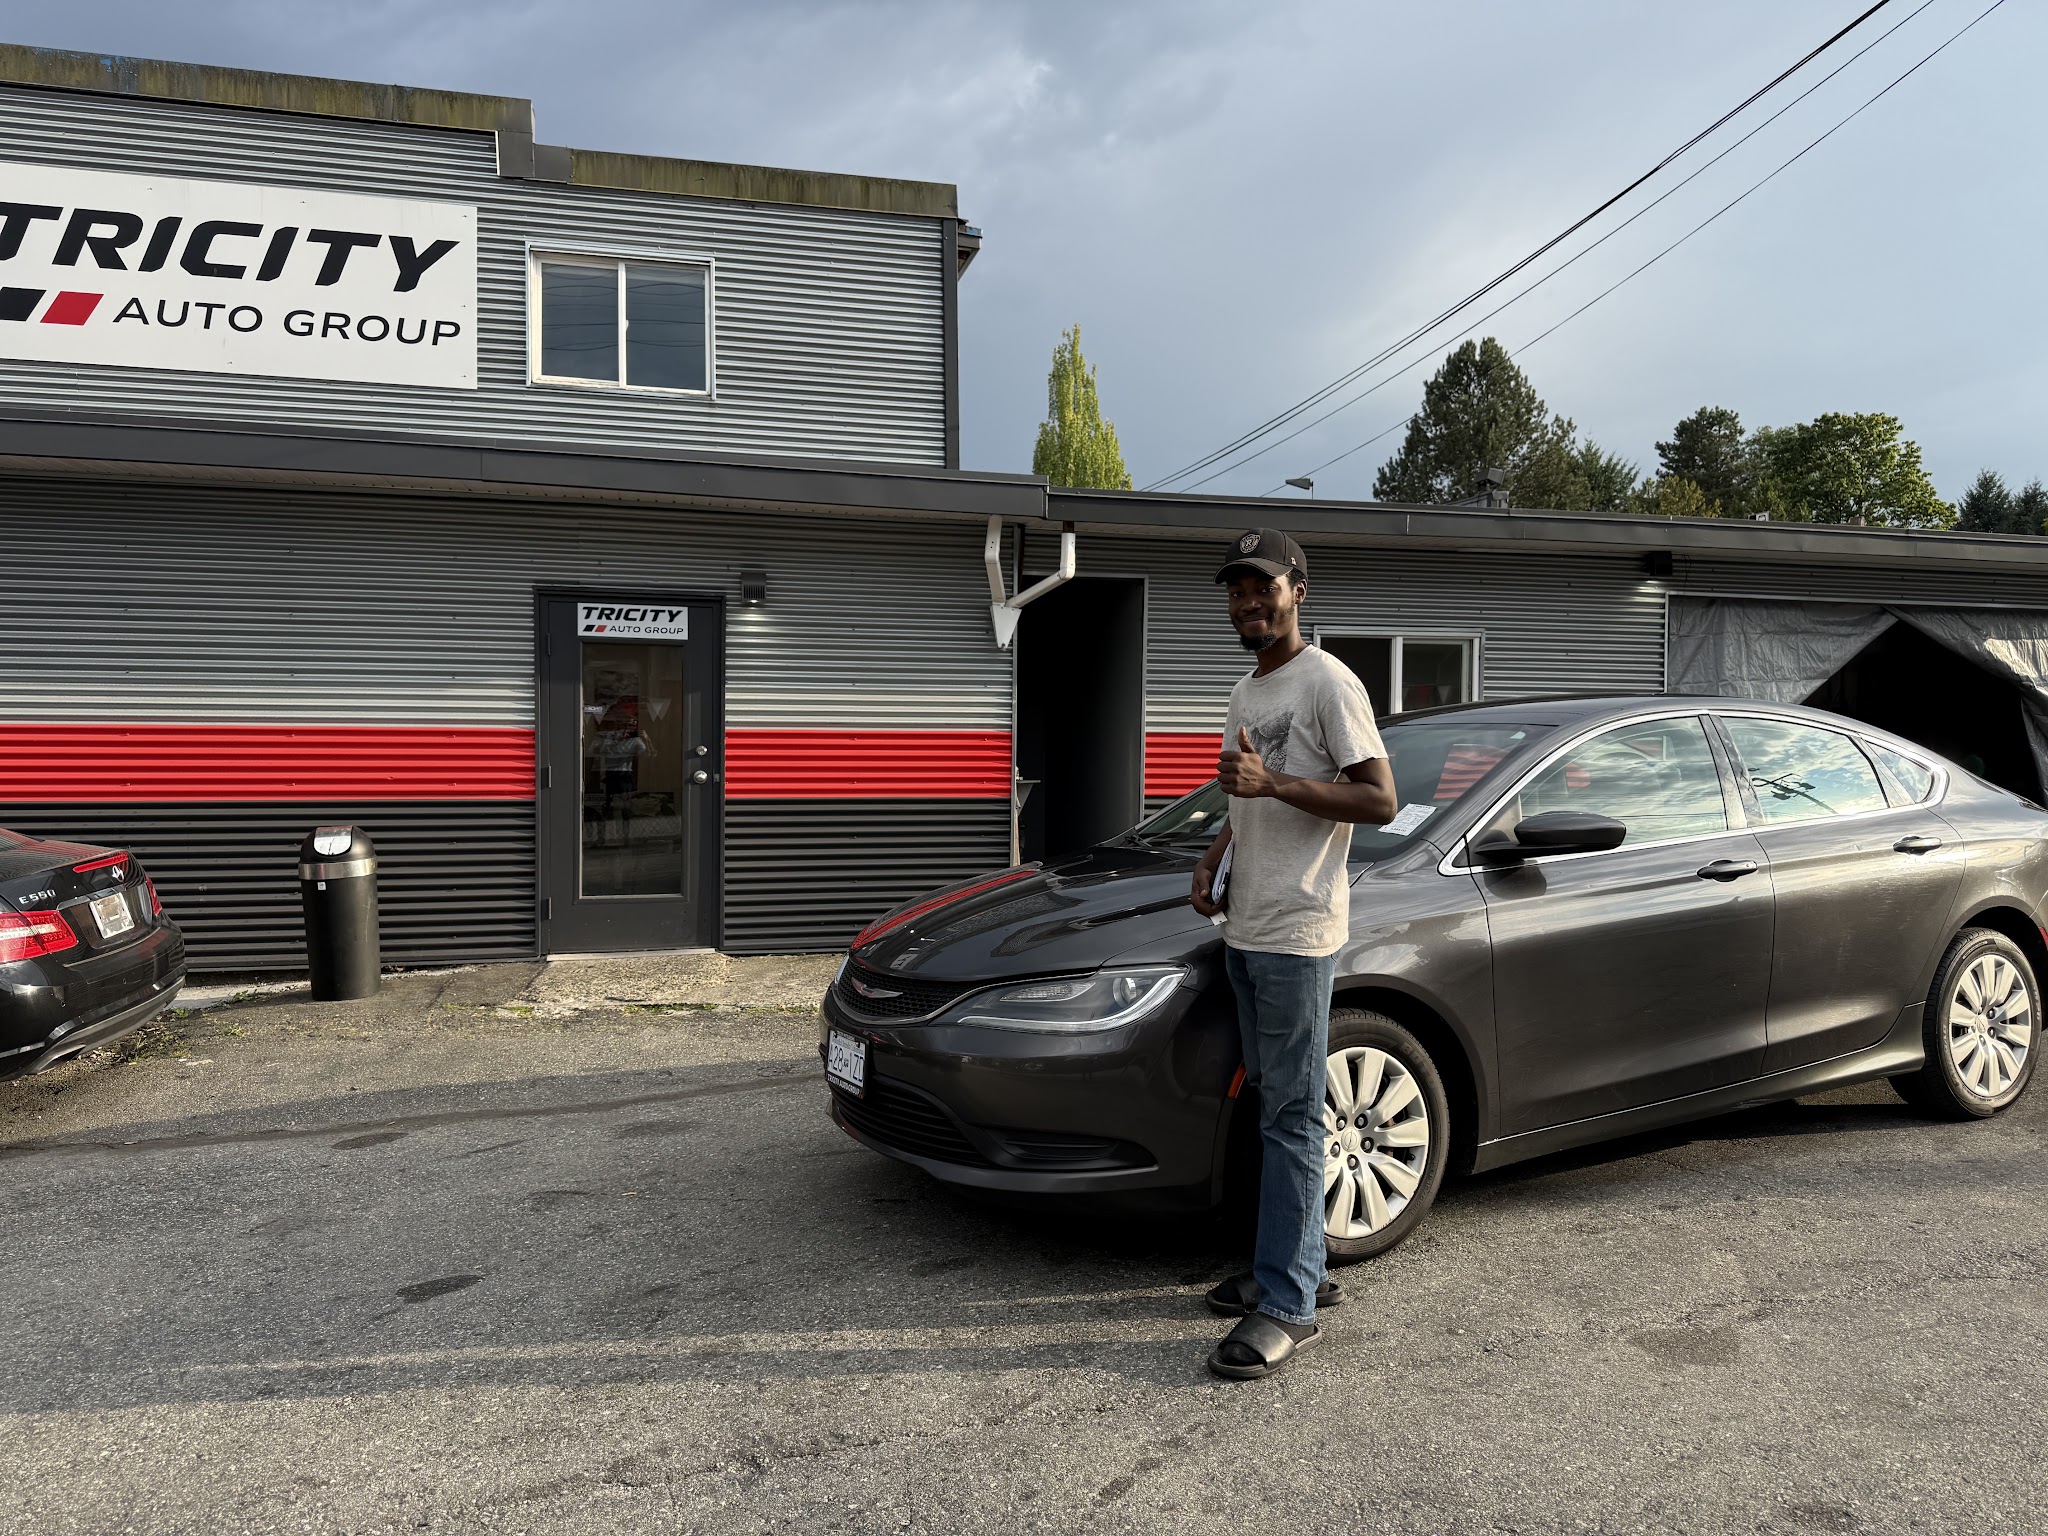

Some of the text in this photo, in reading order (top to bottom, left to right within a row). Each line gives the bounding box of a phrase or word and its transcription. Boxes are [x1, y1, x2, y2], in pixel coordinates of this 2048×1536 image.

[0, 202, 460, 293] TRICITY
[112, 297, 461, 346] AUTO GROUP
[582, 606, 683, 623] TRICITY
[609, 625, 684, 635] AUTO GROUP
